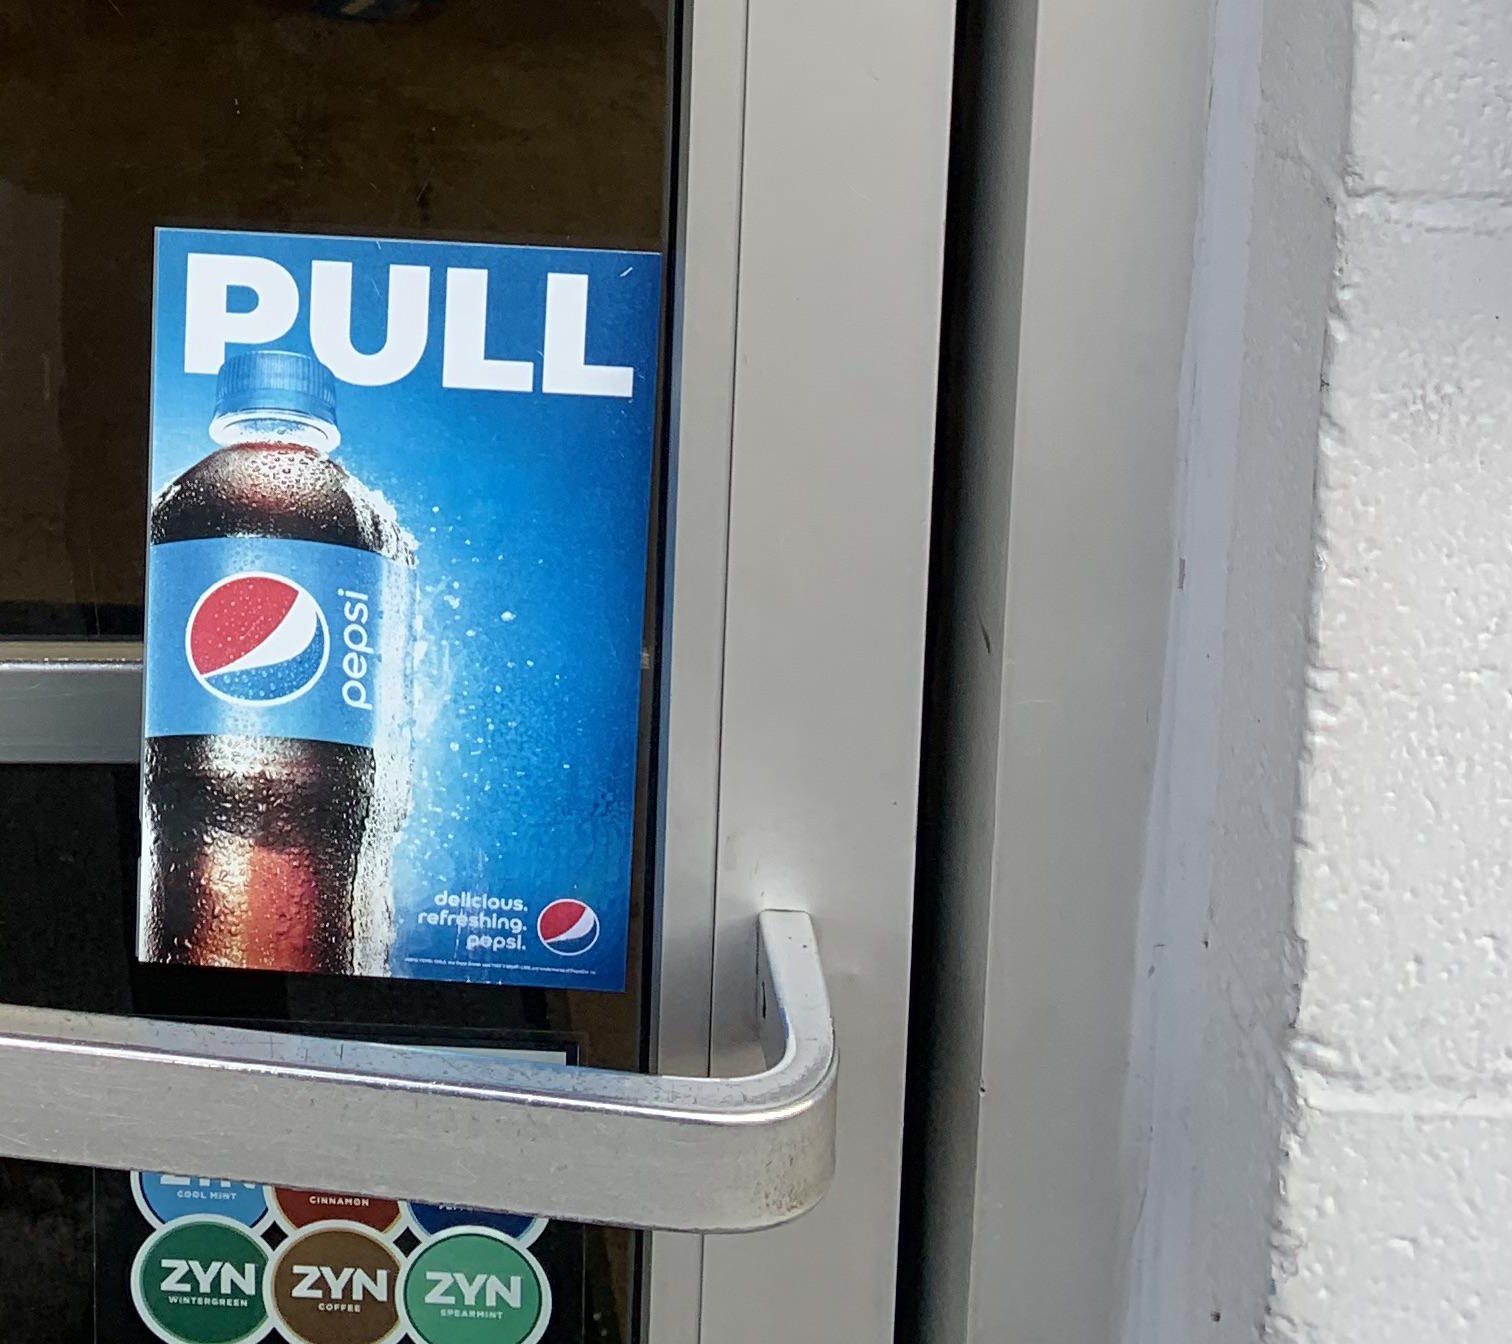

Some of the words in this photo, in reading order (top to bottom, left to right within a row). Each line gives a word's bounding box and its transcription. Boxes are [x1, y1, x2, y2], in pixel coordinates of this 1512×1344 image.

[184, 252, 634, 397] PULL
[338, 588, 374, 710] pepsi
[435, 890, 527, 912] delicious.
[418, 910, 527, 933] refreshing.
[466, 934, 526, 951] pepsi.
[177, 1190, 206, 1199] COOL
[309, 1195, 369, 1207] CINNAMON
[160, 1260, 256, 1295] ZYN
[291, 1265, 387, 1301] ZYN
[424, 1271, 521, 1308] ZYN
[318, 1302, 360, 1313] COFFEE
